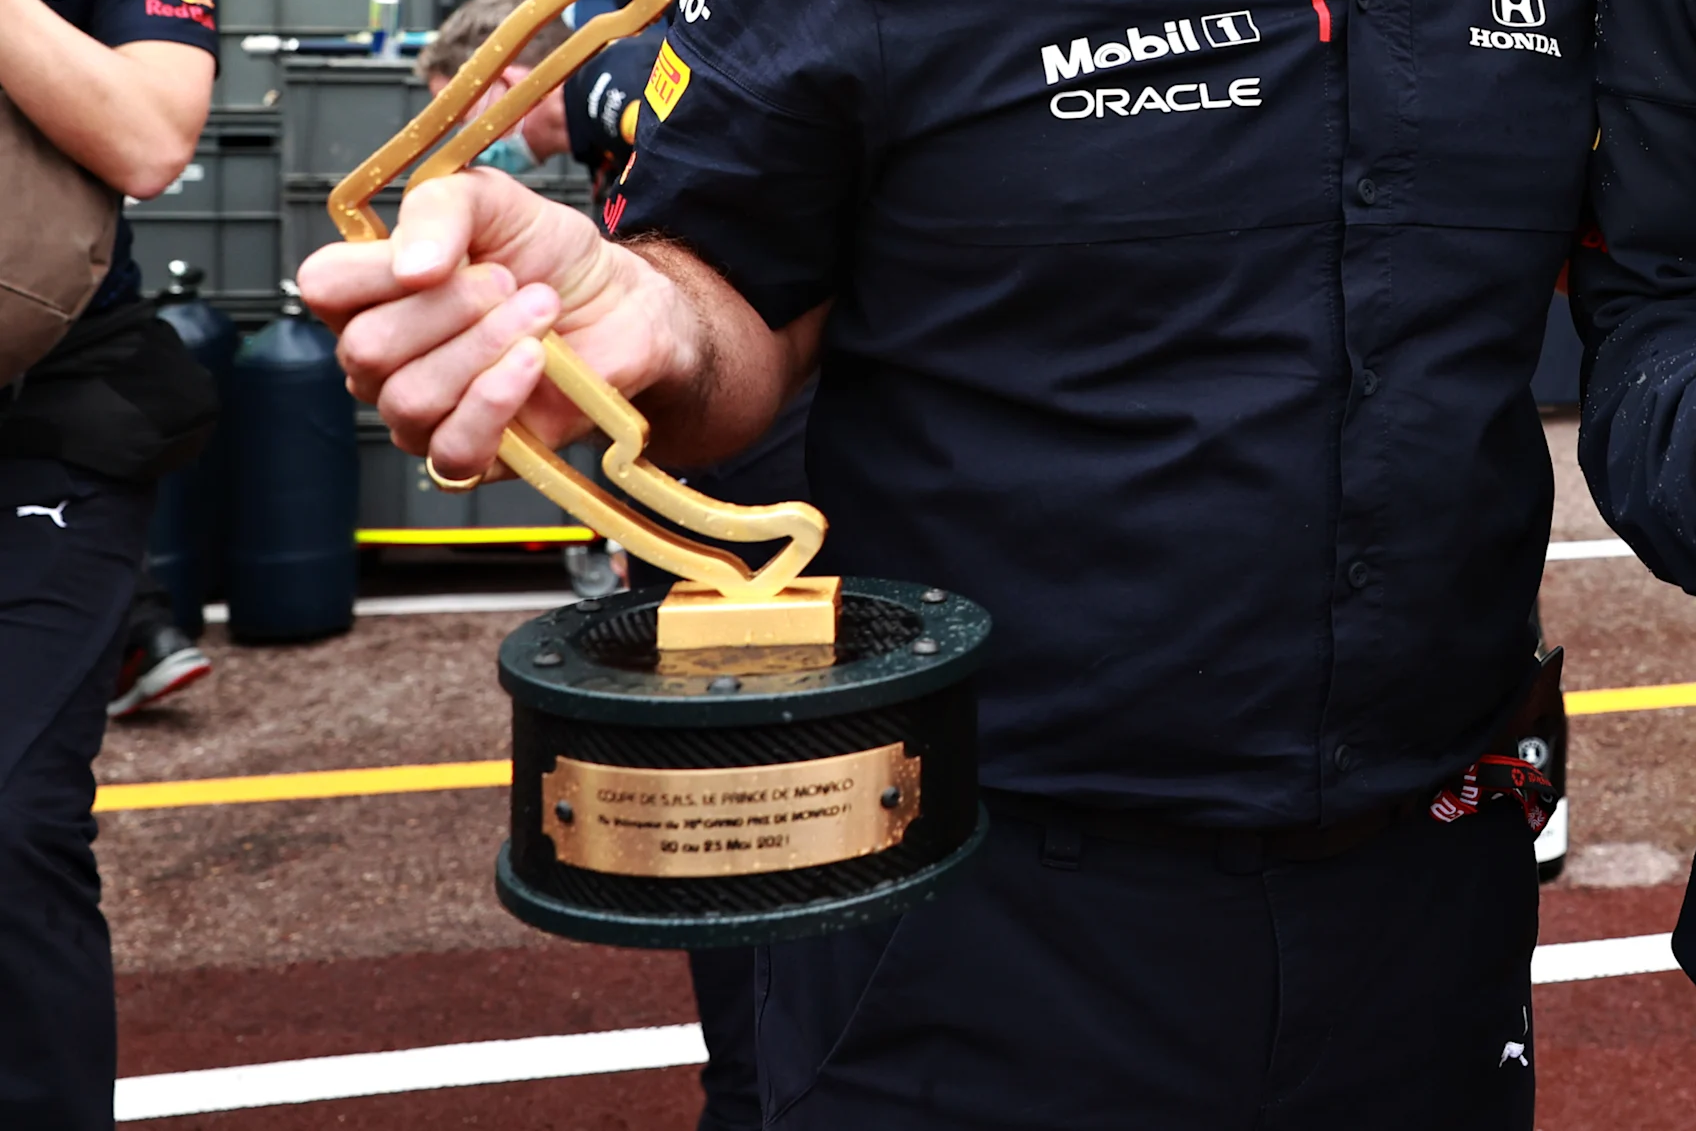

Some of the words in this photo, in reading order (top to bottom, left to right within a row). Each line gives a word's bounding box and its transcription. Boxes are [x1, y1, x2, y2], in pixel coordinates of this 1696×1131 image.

[1041, 18, 1201, 85] Mobil
[1469, 26, 1562, 58] HONDA
[1049, 77, 1263, 120] ORACLE
[793, 777, 854, 798] MONACO
